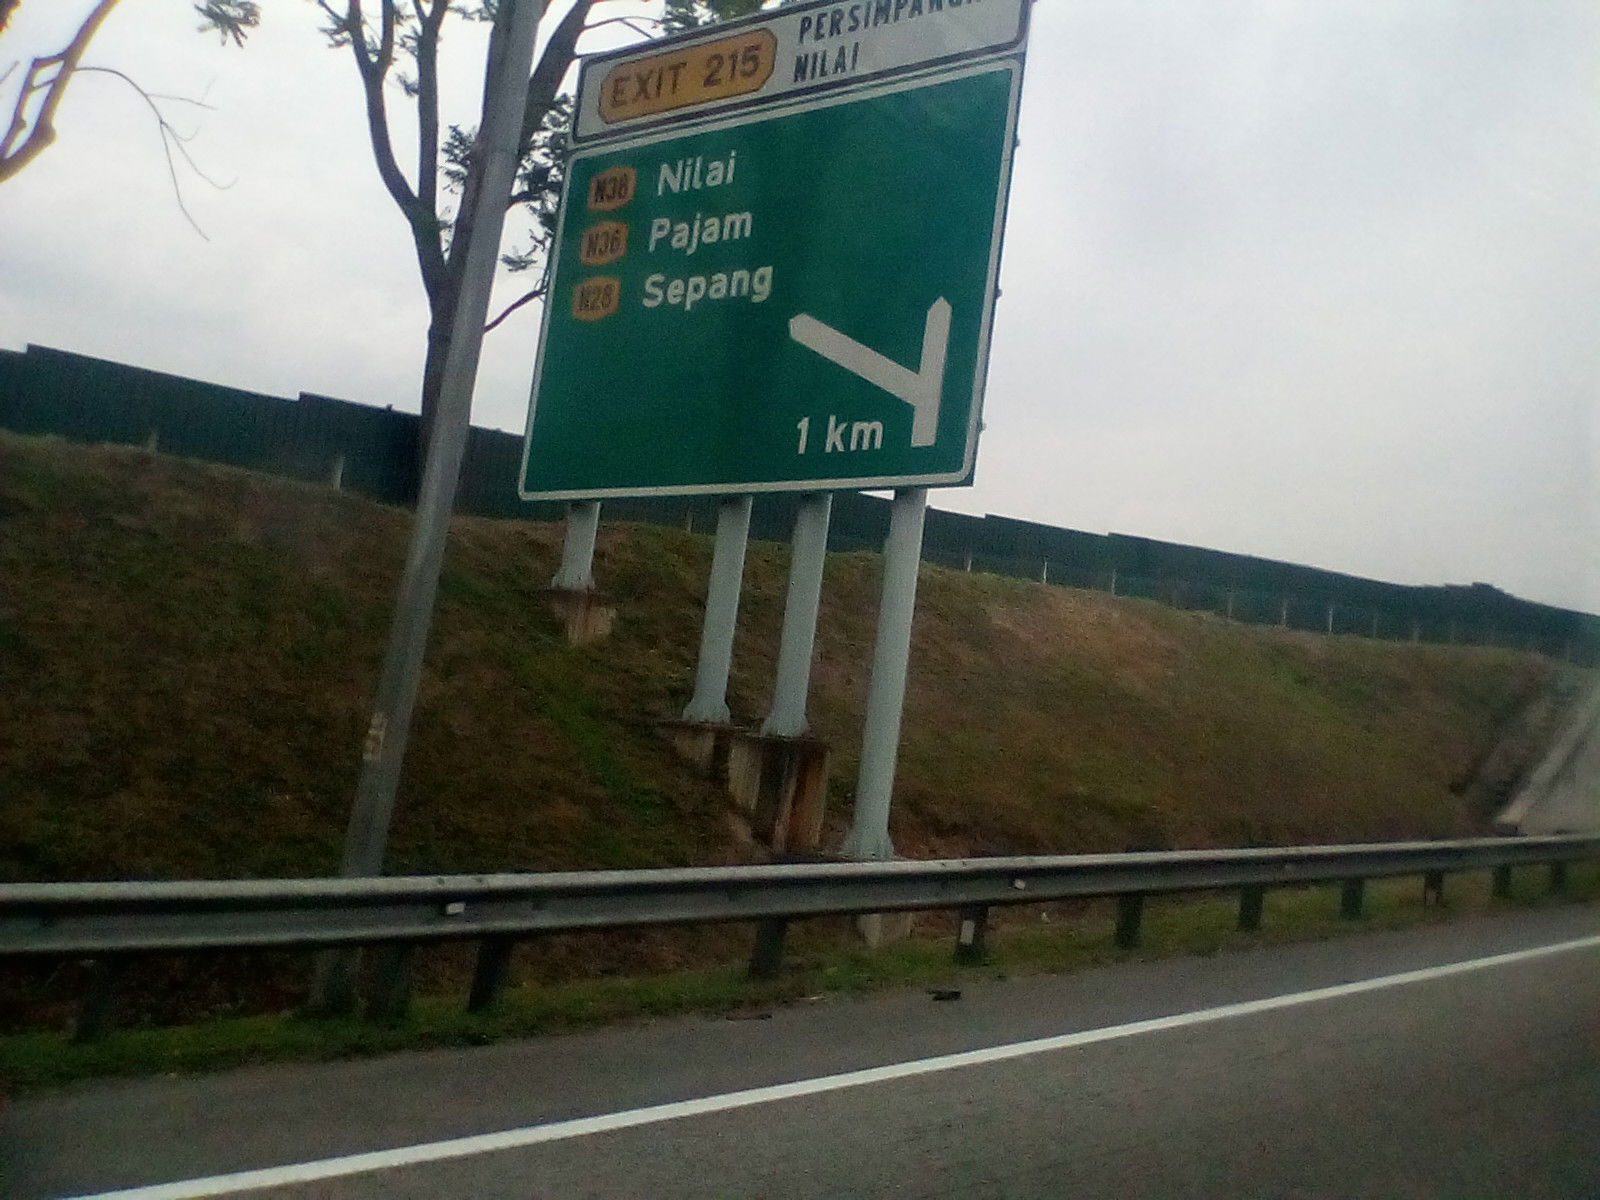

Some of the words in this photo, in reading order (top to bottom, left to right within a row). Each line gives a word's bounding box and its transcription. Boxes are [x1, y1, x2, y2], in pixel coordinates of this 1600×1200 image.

[610, 62, 687, 108] EXIT
[703, 44, 761, 88] 215
[794, 42, 859, 83] NILAI
[658, 150, 736, 196] Nilai
[649, 212, 752, 256] Pajam
[642, 265, 774, 311] Sepang
[797, 416, 810, 455] 1
[825, 414, 884, 453] km
